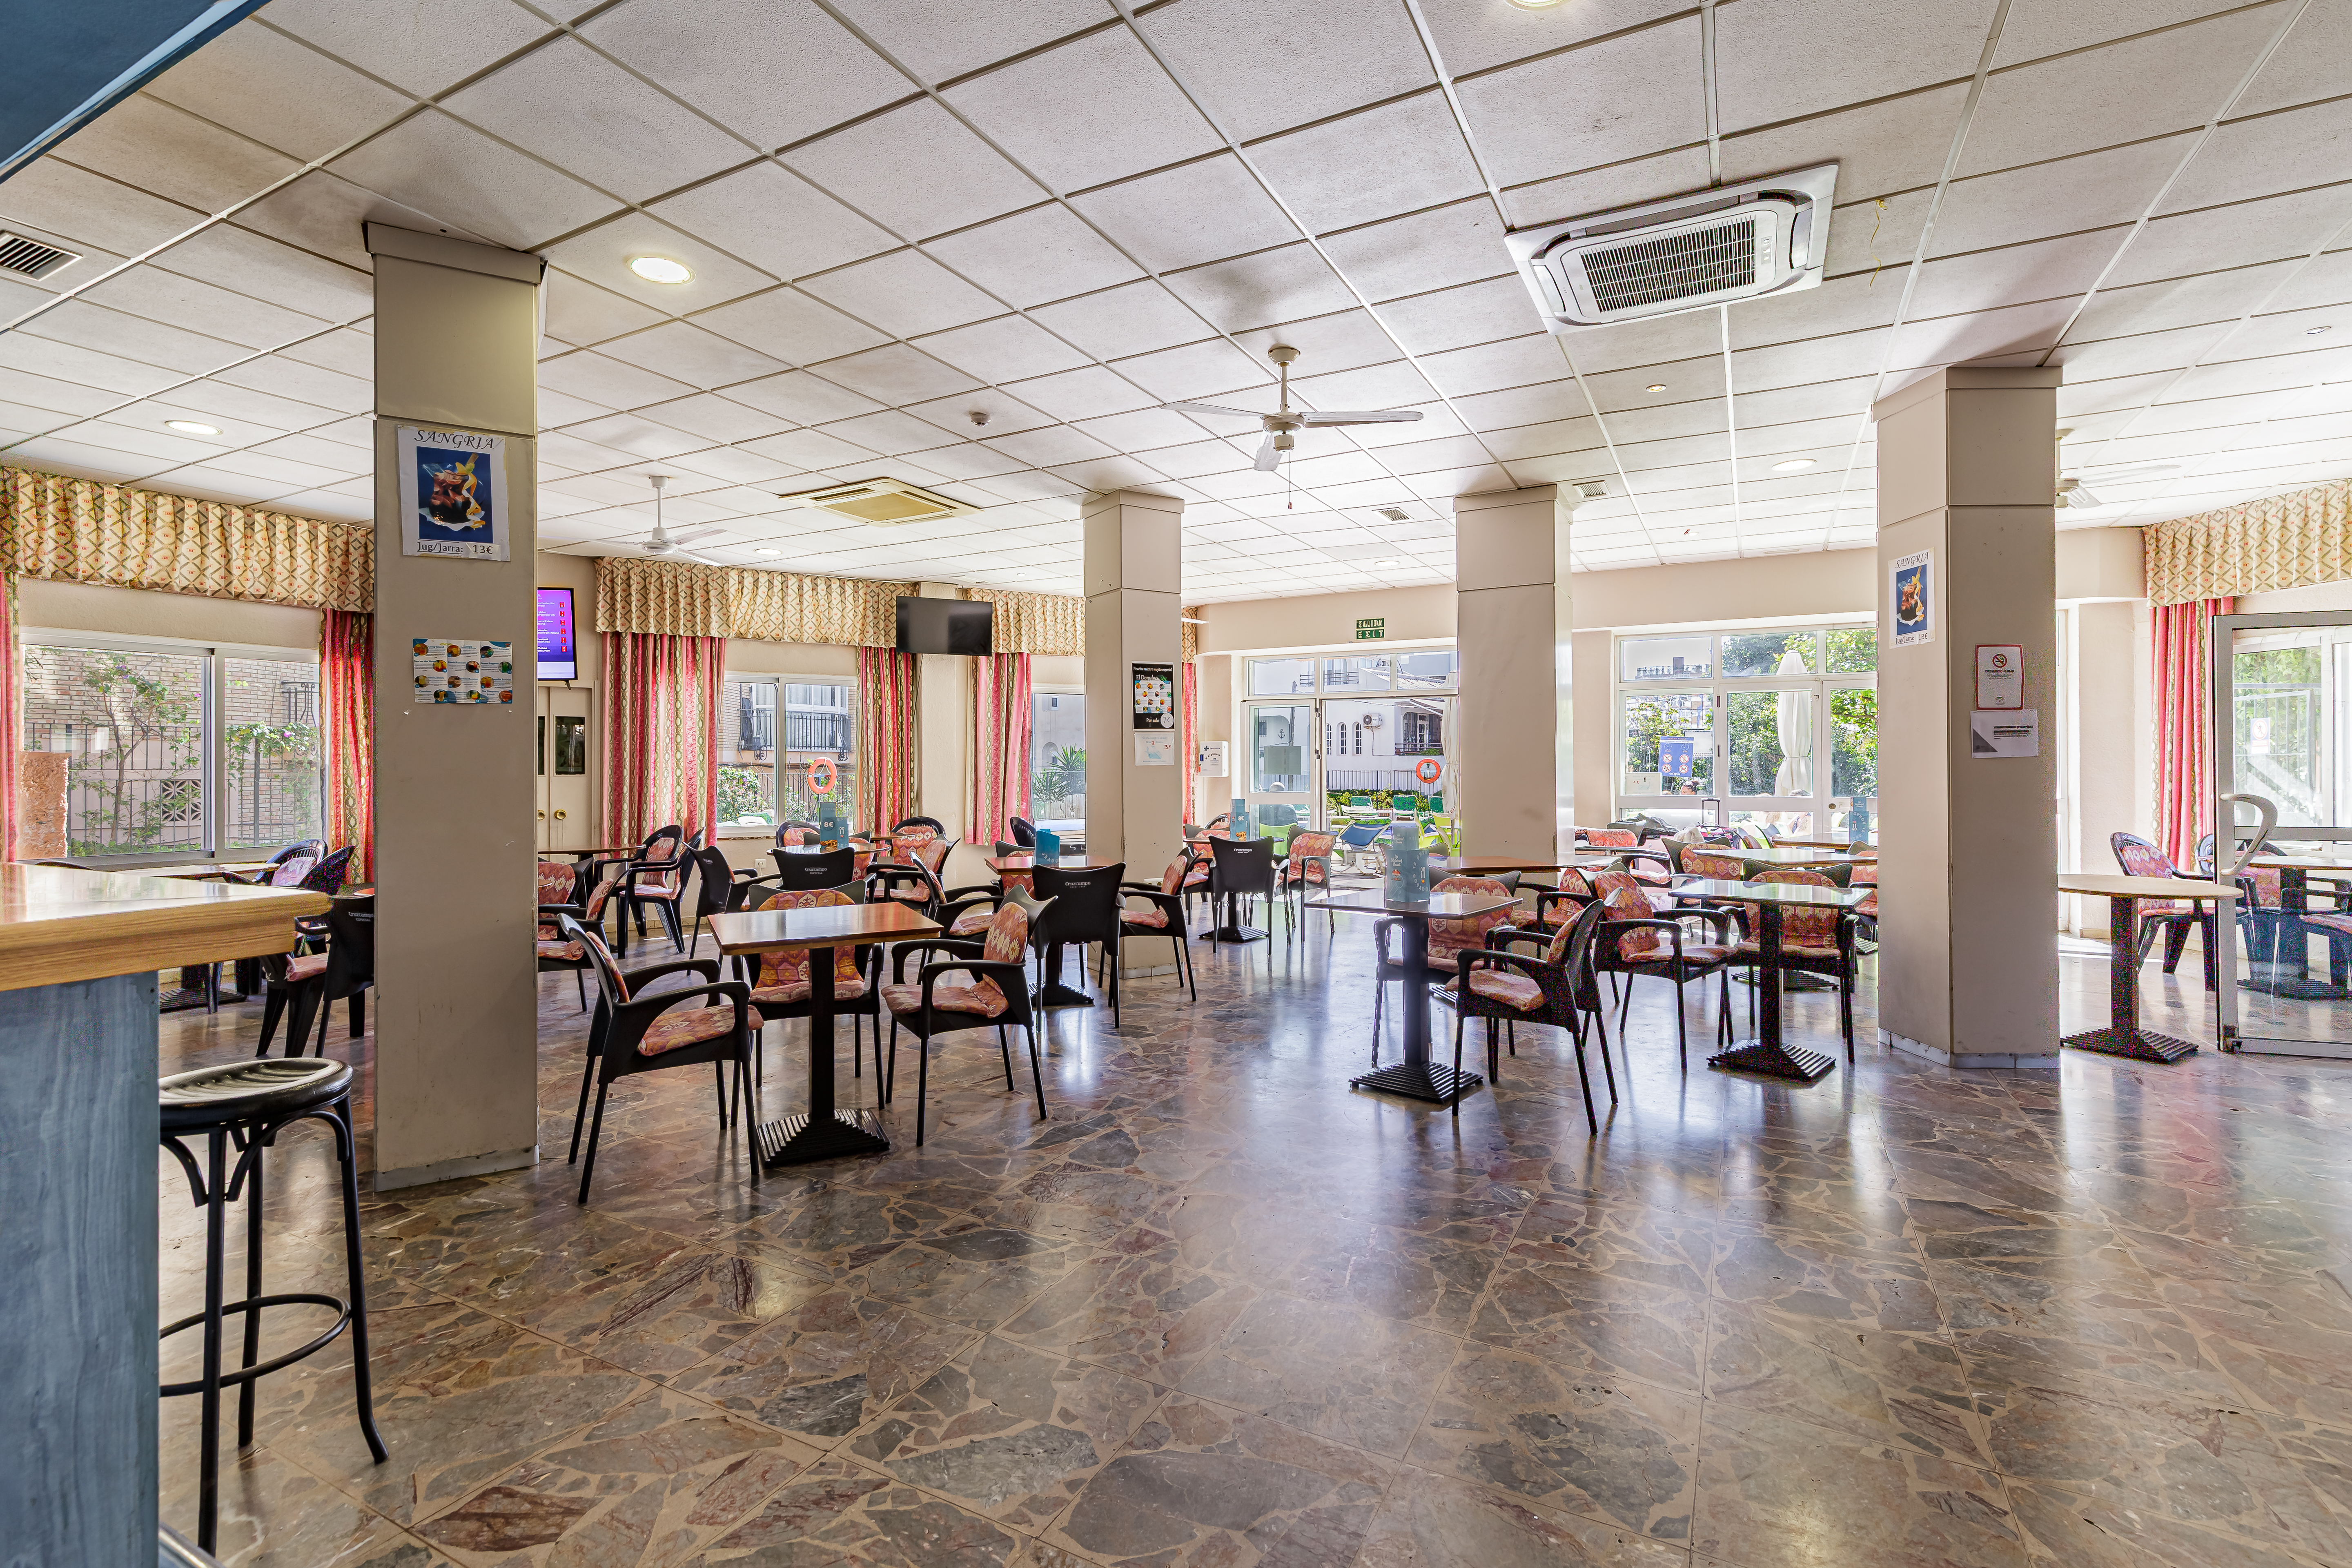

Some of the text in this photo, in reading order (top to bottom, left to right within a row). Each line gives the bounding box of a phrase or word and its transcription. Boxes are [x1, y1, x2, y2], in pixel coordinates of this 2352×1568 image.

[414, 430, 494, 449] SANGRIA
[417, 542, 493, 554] Jug/Jarra: 13€
[1895, 552, 1929, 568] SANGRIA
[1359, 619, 1383, 628] SALIDA
[1358, 630, 1383, 638] EXIT
[1895, 636, 1915, 645] Jug/Jarra:
